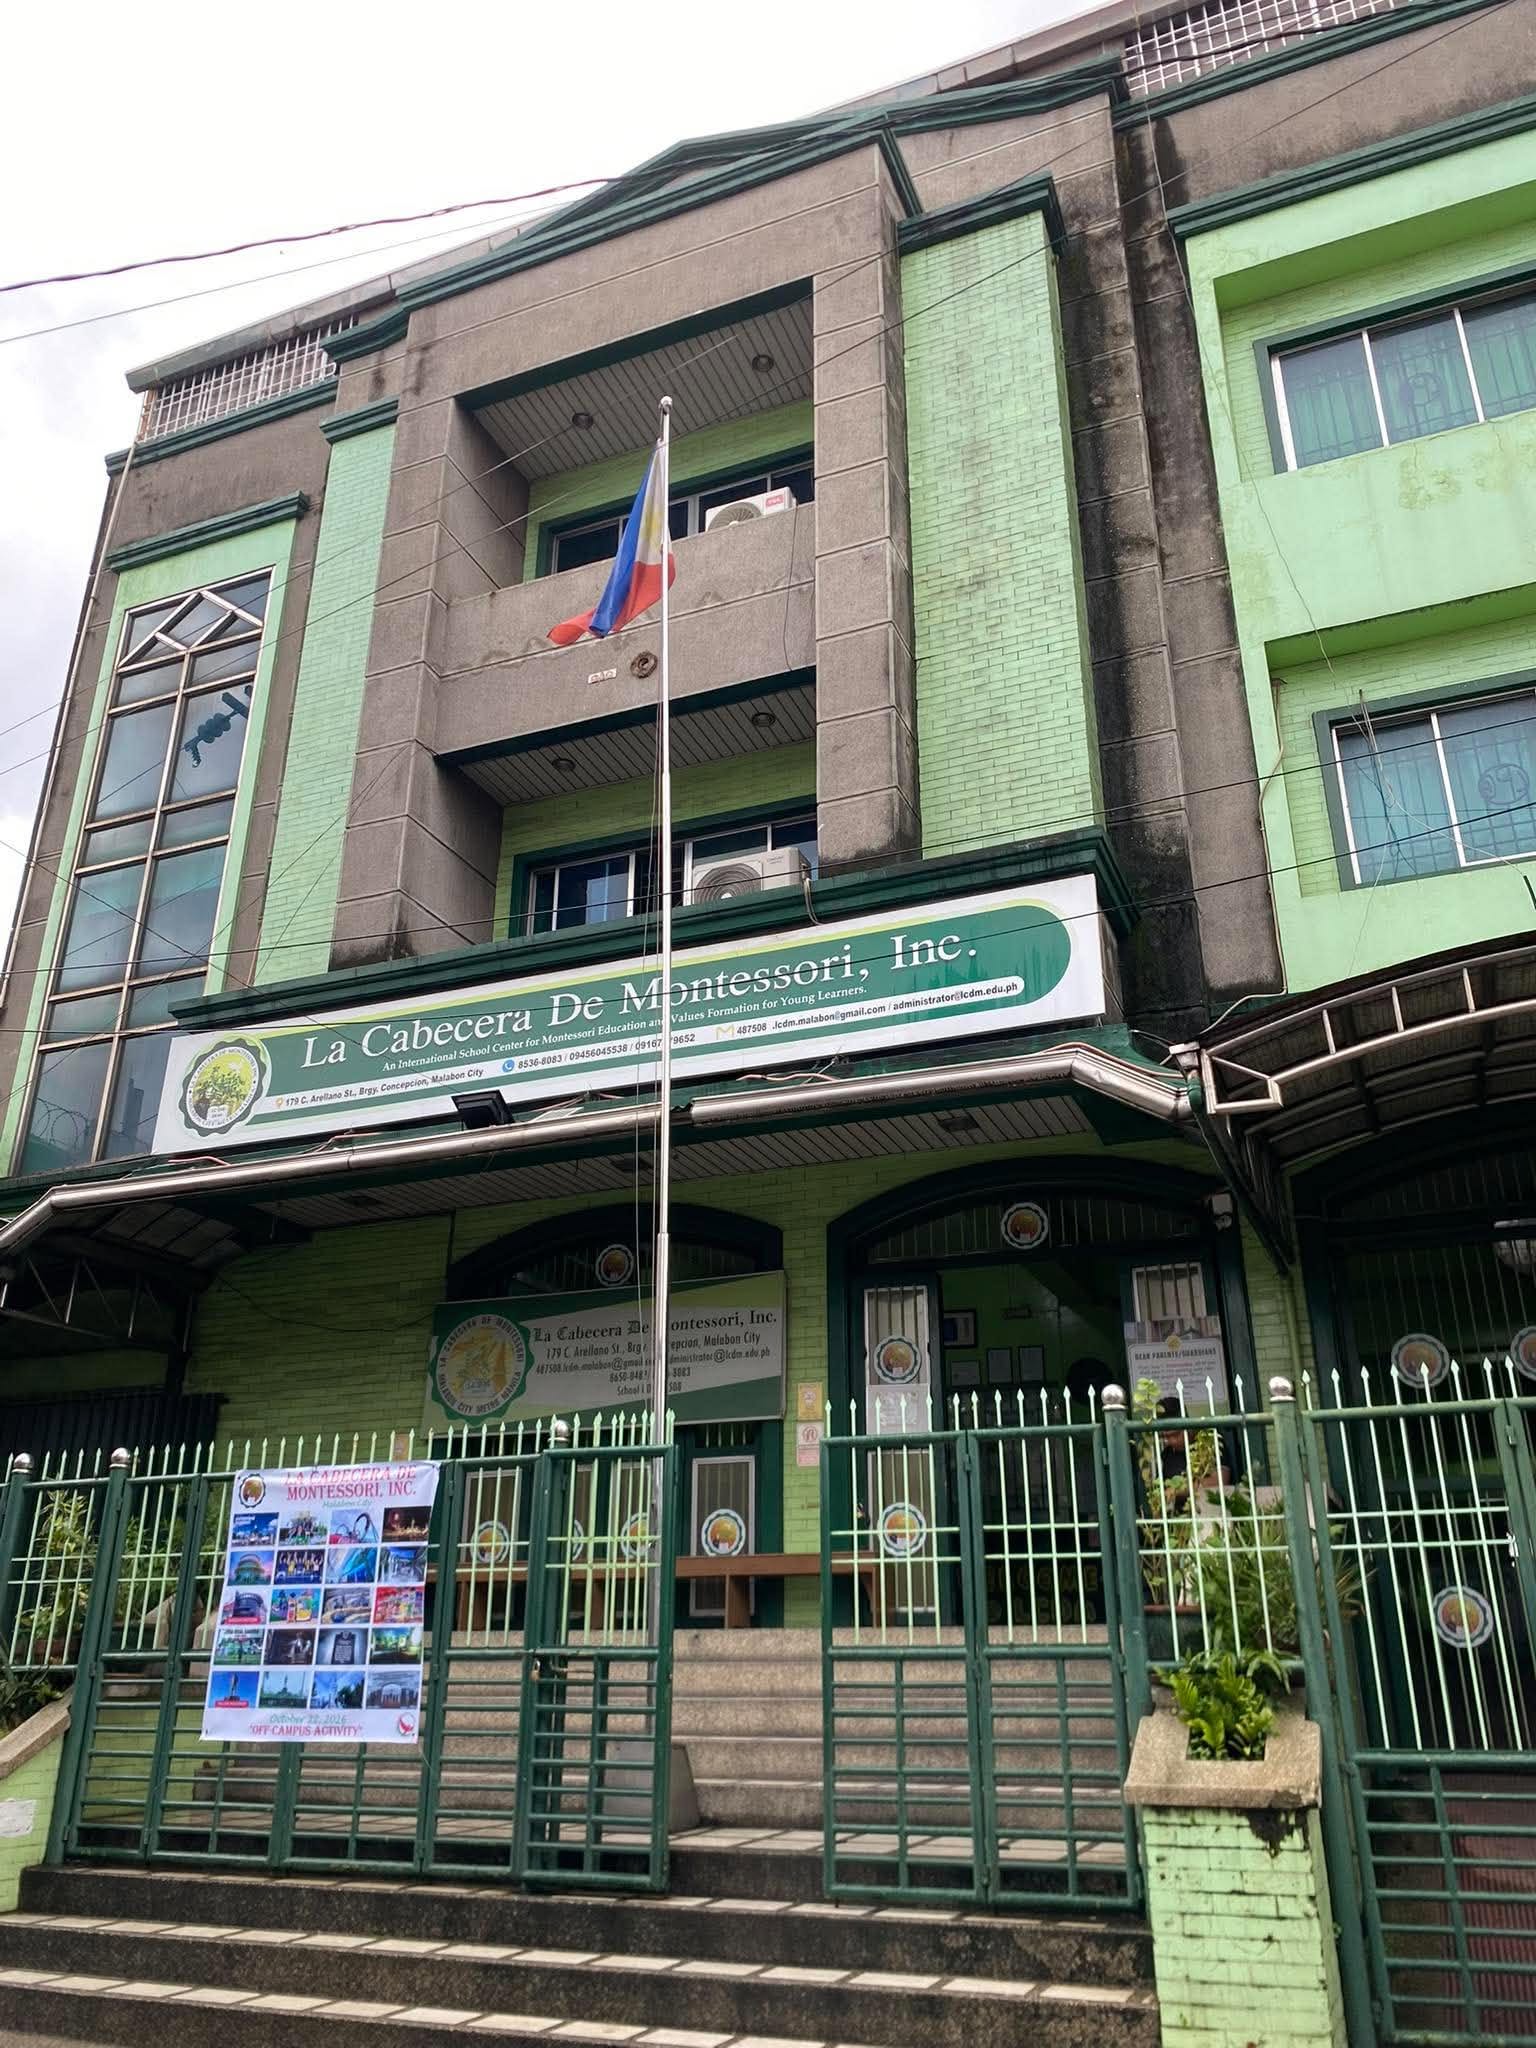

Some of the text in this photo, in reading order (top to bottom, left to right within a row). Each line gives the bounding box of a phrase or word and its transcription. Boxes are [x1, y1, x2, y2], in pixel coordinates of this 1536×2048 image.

[300, 930, 978, 1069] La Cabecera De Montessori, Inc.
[736, 1023, 767, 1036] 487508
[892, 982, 1019, 1012] administrator@lcdm.edu.ph
[382, 1062, 396, 1072] An
[398, 1053, 456, 1069] International
[458, 1043, 491, 1060] School
[492, 1037, 523, 1053] Center
[525, 1035, 540, 1047] for
[542, 1028, 595, 1045] Montessori
[597, 1020, 647, 1035] Education
[671, 1012, 705, 1025] Values
[706, 1001, 761, 1018] Formation
[761, 998, 778, 1010] for
[779, 992, 816, 1010] Young
[817, 986, 868, 1003] Learners.
[518, 1055, 562, 1070] 8536-8083
[569, 1044, 628, 1061] 09456045538
[635, 1033, 696, 1051] 091679652
[286, 1097, 299, 1107] 179
[300, 1096, 309, 1104] C.
[310, 1092, 342, 1104] Arellano
[359, 1086, 379, 1098] Brgy.
[380, 1078, 430, 1093] Concepcion,
[431, 1072, 465, 1084] Malabon
[467, 1068, 484, 1078] City
[534, 1310, 777, 1343] La Cabecera De ontessori, Inc.
[546, 1347, 562, 1360] 179
[573, 1343, 609, 1358] Arellano
[703, 1334, 741, 1347] Malabon
[743, 1331, 761, 1345] City
[309, 1466, 392, 1483] CABECERA
[396, 1465, 417, 1479] DE
[388, 1480, 417, 1496] INC.
[269, 1713, 304, 1725] October
